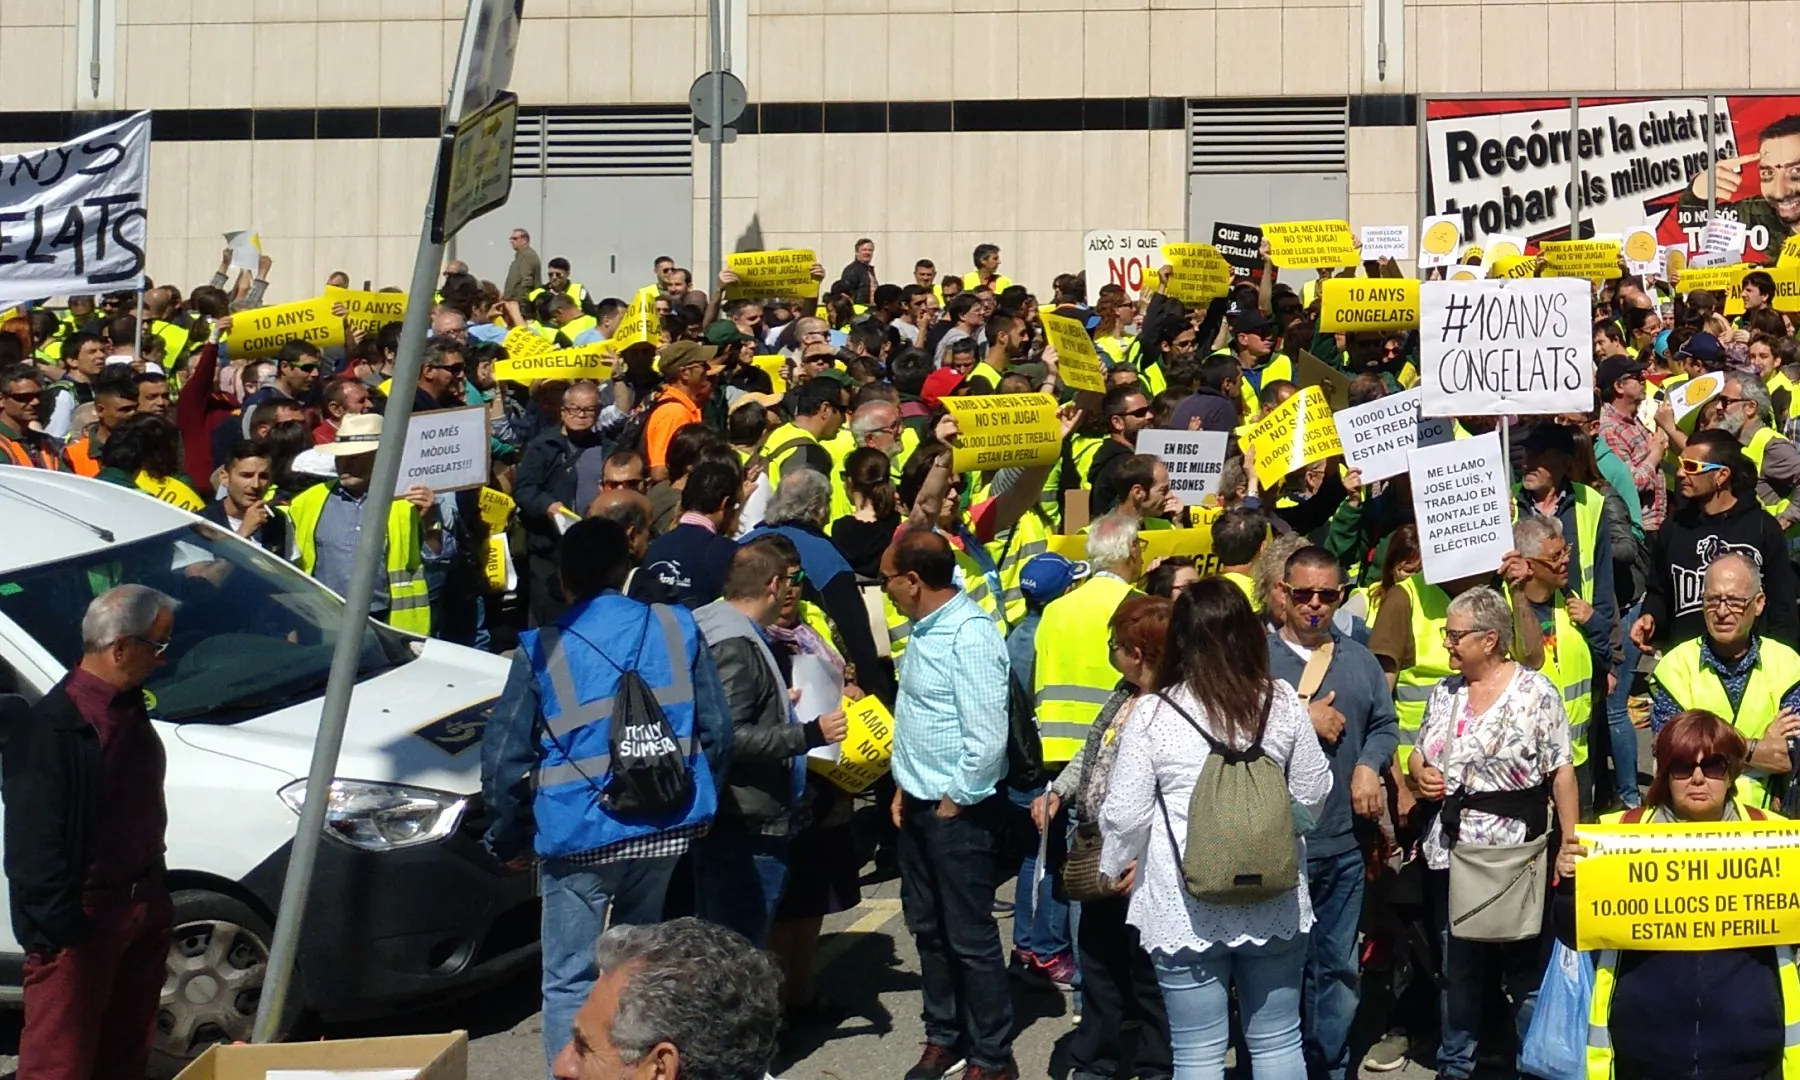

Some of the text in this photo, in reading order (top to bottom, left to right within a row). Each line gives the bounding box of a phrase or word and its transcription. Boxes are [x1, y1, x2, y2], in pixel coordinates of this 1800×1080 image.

[1609, 116, 1636, 153] la
[1639, 108, 1697, 146] ciutat
[0, 131, 126, 186] NYS
[1611, 153, 1687, 199] millors
[1682, 140, 1734, 182] pres?
[1678, 211, 1691, 224] JO
[1695, 210, 1709, 223] NO
[1218, 228, 1240, 241] QUE
[1269, 223, 1349, 234] AMB LA MEVA FEINA
[0, 192, 148, 285] ELATS
[1137, 238, 1158, 249] QUE
[1284, 233, 1338, 244] NO S'HI JUGA!
[1563, 244, 1573, 252] LA
[1574, 243, 1595, 251] MEVA
[1595, 242, 1617, 250] FEINA
[1294, 245, 1354, 255] LLOCS DE TREBALL
[1555, 253, 1567, 261] NO
[734, 258, 753, 266] AMB
[755, 257, 765, 266] LA
[767, 255, 790, 264] MEVA
[1288, 255, 1342, 265] ESTAN EN PERILL
[747, 268, 758, 276] NO
[1348, 287, 1405, 302] 10 ANYS
[364, 302, 403, 315] ANYS
[1335, 309, 1415, 323] CONGELATS
[254, 309, 315, 331] 10 ANYS
[1441, 292, 1568, 344] #10ANYS
[243, 326, 329, 352] CONGEATS
[511, 354, 600, 370] CONGELATS
[1438, 346, 1581, 395] CONGELATS
[953, 395, 1052, 411] AMB LA MEVA FEINA
[975, 410, 1040, 427] NO S'HI JUGA!
[1247, 408, 1291, 443] AMB LA
[1348, 410, 1385, 429] 10000
[420, 426, 460, 440] NO MÉS
[987, 431, 1057, 447] LLOCS DE TREBALL
[1269, 425, 1288, 442] NO
[1355, 430, 1372, 443] DE
[420, 444, 461, 459] MÒDULS
[1164, 443, 1199, 455] EN RISC
[1317, 441, 1331, 452] EN
[1352, 425, 1444, 462] ESTAN EN JOC
[978, 448, 1039, 464] ESTAN EN PERILL
[1260, 442, 1290, 468] 10.000
[1176, 462, 1222, 474] DE MILERS
[1427, 457, 1486, 479] ME LLAMO
[1423, 480, 1453, 495] JOSE
[1486, 471, 1494, 482] Y
[1424, 486, 1496, 509] TRABAJO EN
[1427, 500, 1498, 525] MONTAJE DE
[1428, 515, 1501, 540] APARELLAJE
[1434, 532, 1500, 554] ELÉCTRICO.
[859, 709, 889, 741] AMB
[857, 740, 880, 762] NO
[1628, 857, 1781, 883] NO S'HI JUGA!
[1591, 898, 1648, 916] 10.000
[1654, 896, 1709, 915] LLOCS
[1715, 894, 1737, 912] DE
[1632, 918, 1780, 940] ESTAN EN PERILL
